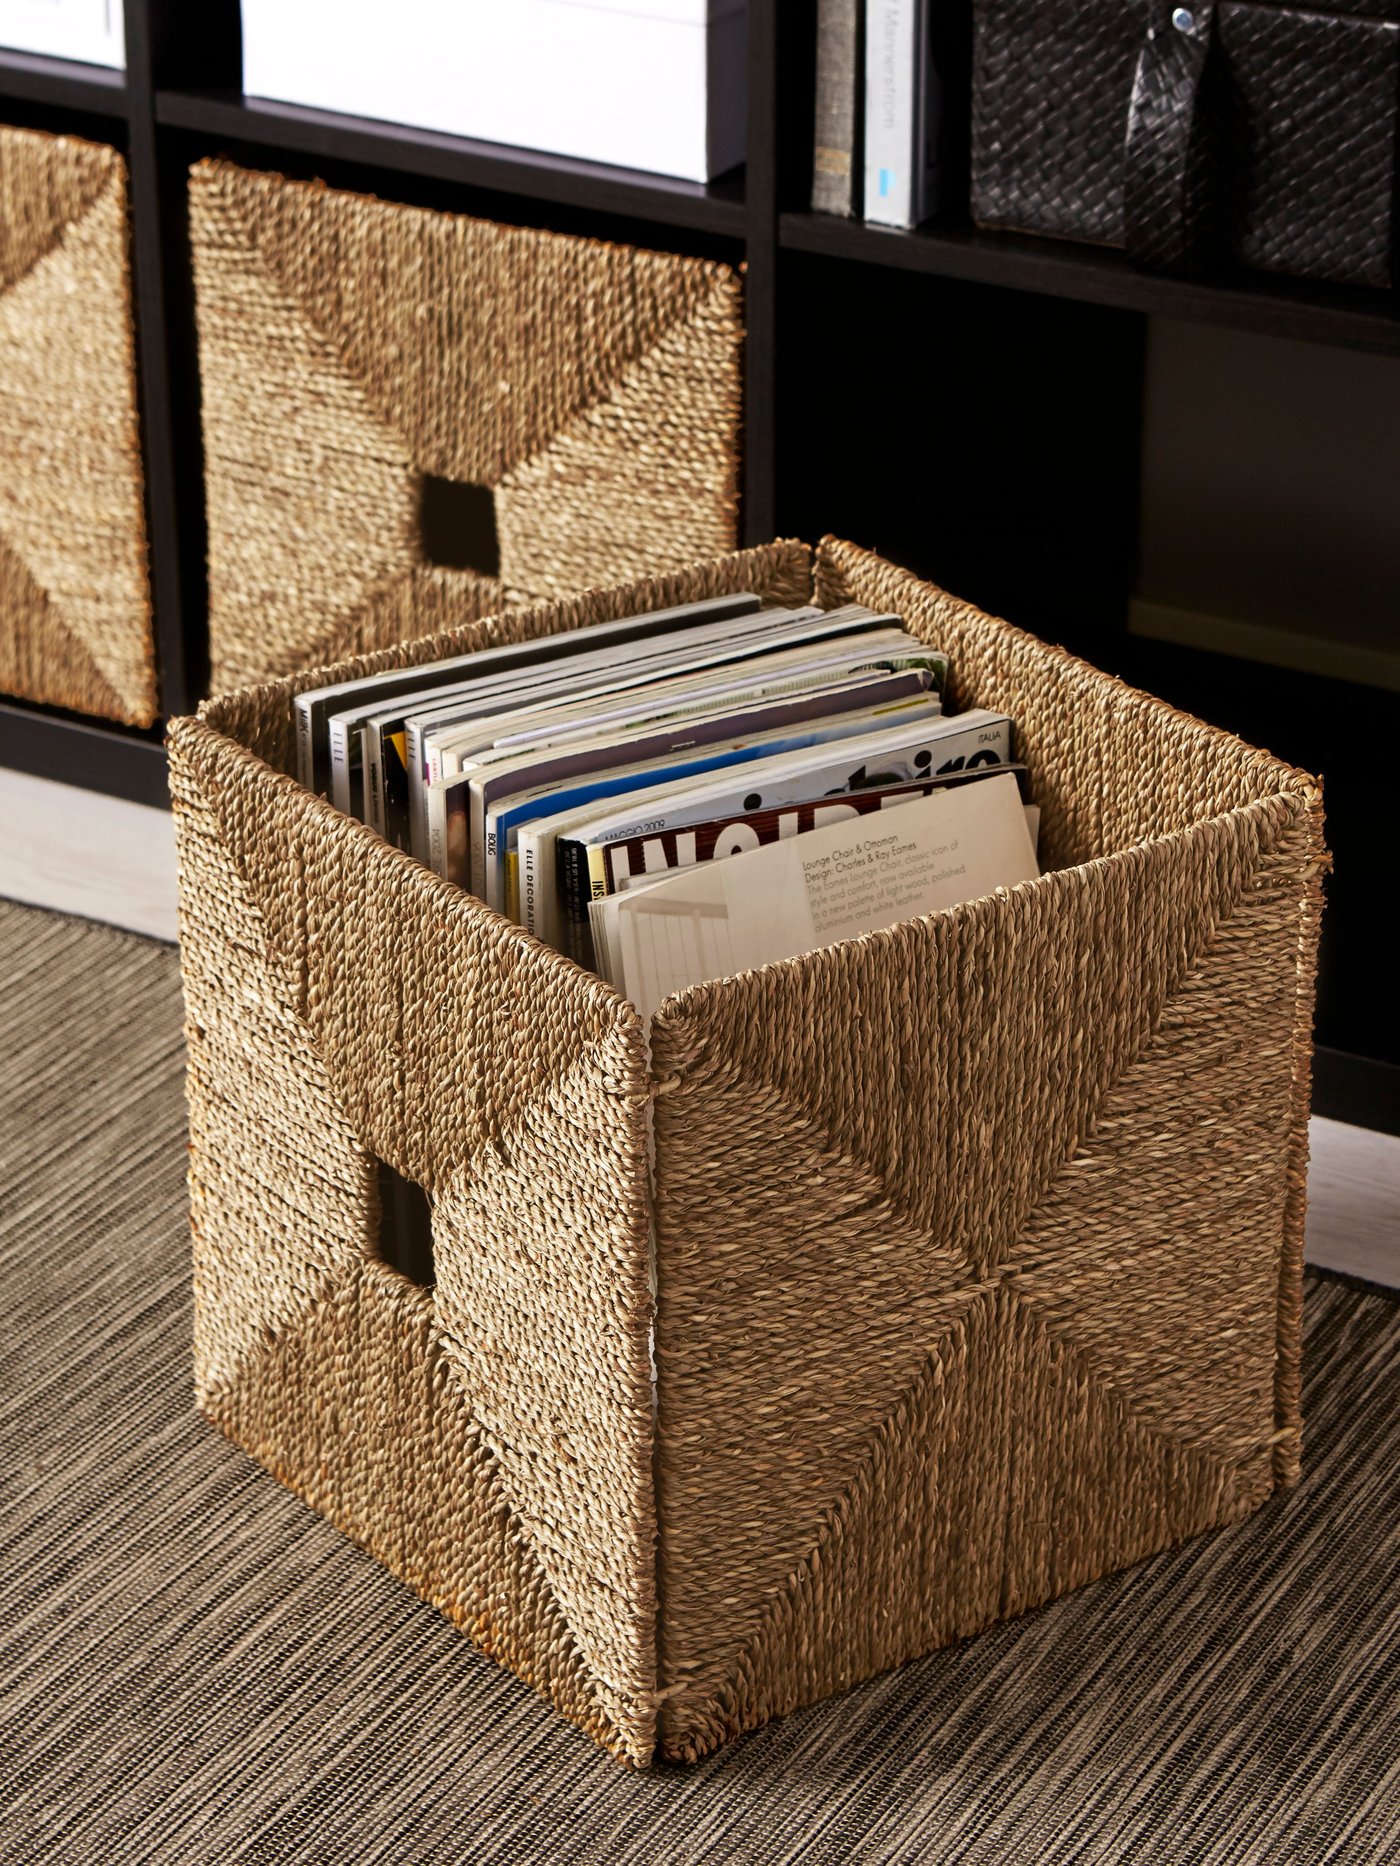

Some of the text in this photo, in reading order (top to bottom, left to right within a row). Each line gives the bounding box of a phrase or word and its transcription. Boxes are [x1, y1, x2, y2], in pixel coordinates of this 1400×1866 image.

[978, 730, 1001, 744] ITALIA
[802, 835, 898, 871] Lounge Chair & Ottoman
[804, 842, 917, 884] Design: Charles & Ray Eames
[808, 884, 822, 895] The
[823, 876, 848, 890] Eames
[850, 867, 878, 883] Lounge
[905, 850, 930, 865] classic
[931, 844, 949, 858] icon
[950, 840, 959, 851] of
[526, 875, 535, 936] DECORATIO
[810, 896, 828, 909] style
[830, 888, 845, 901] and
[879, 874, 897, 887] now
[898, 862, 935, 880] available
[829, 903, 846, 915] new
[886, 884, 903, 898] light
[931, 864, 966, 883] polished
[855, 906, 872, 919] and
[872, 900, 894, 914] white
